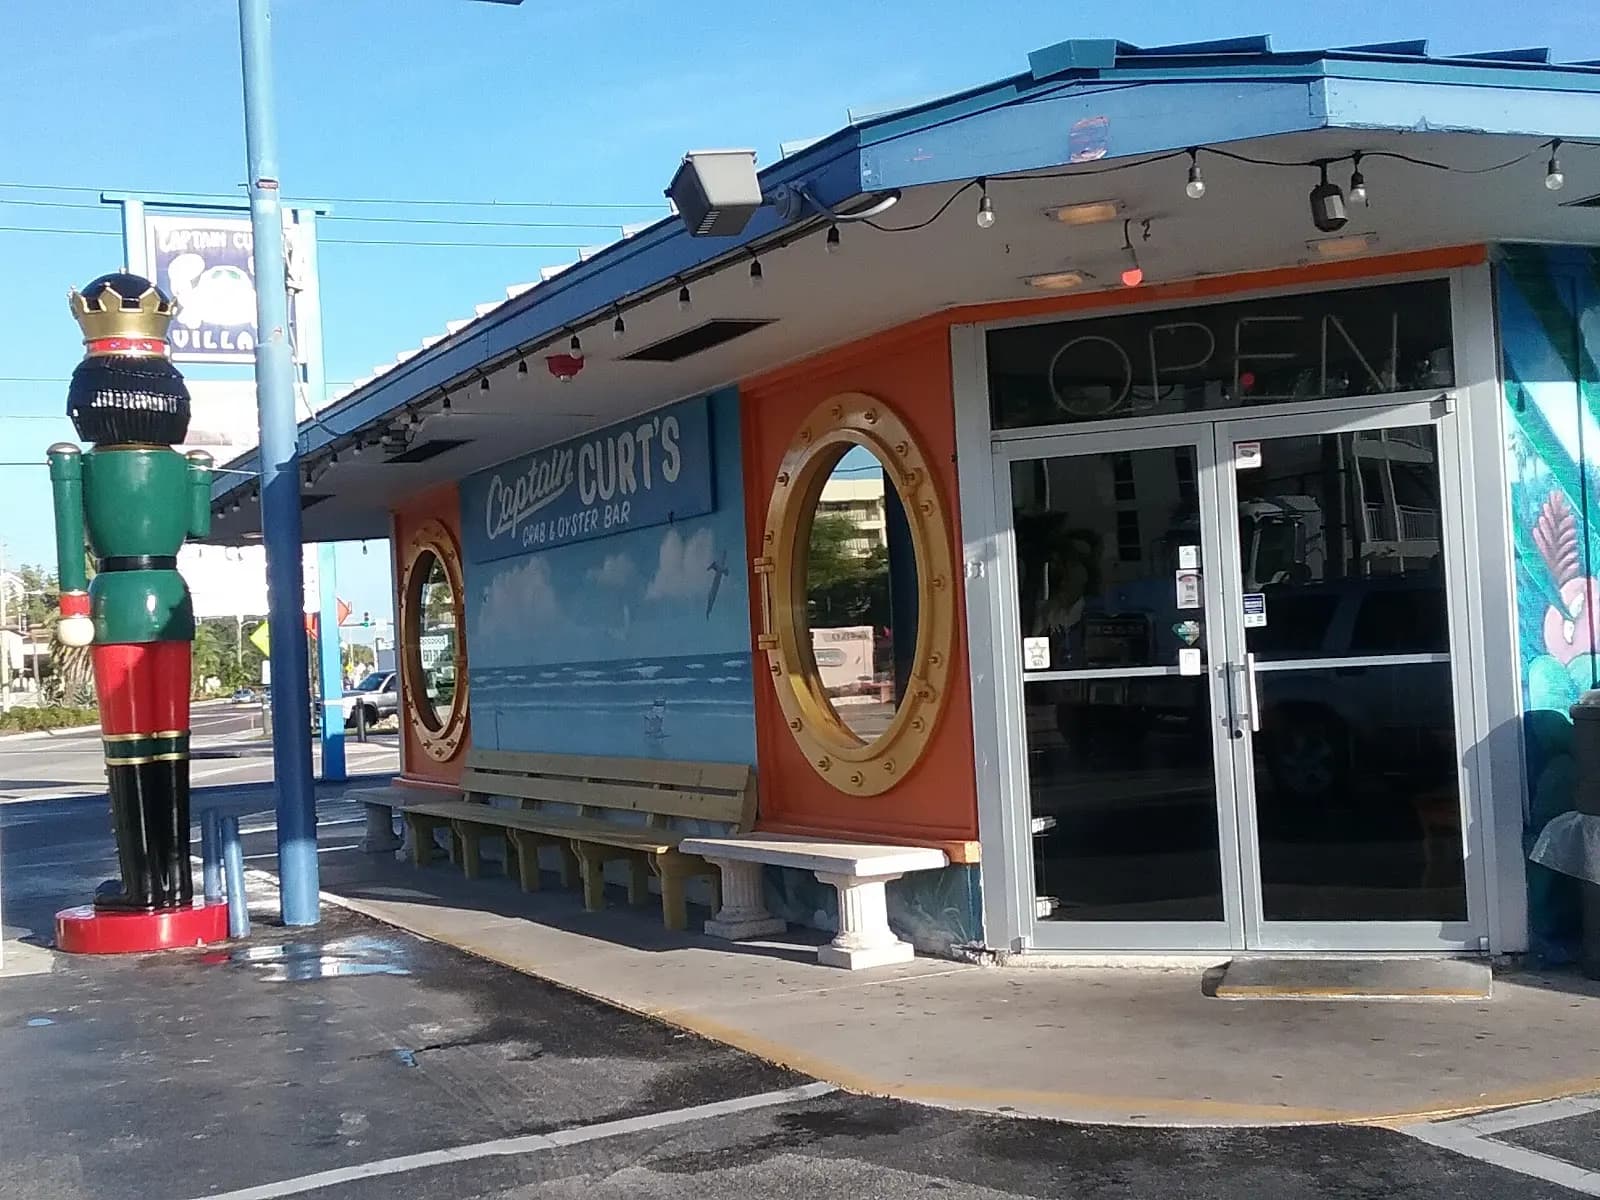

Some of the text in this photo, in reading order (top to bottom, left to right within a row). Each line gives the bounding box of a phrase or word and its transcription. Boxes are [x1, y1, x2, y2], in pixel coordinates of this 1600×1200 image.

[158, 229, 227, 253] CAPTAIN
[172, 329, 255, 350] VILLA
[1049, 313, 1398, 415] OPEN
[486, 416, 681, 540] Captain CURT'S
[522, 520, 546, 548] CRAB
[556, 508, 599, 538] OYSTER
[604, 501, 631, 529] BAR
